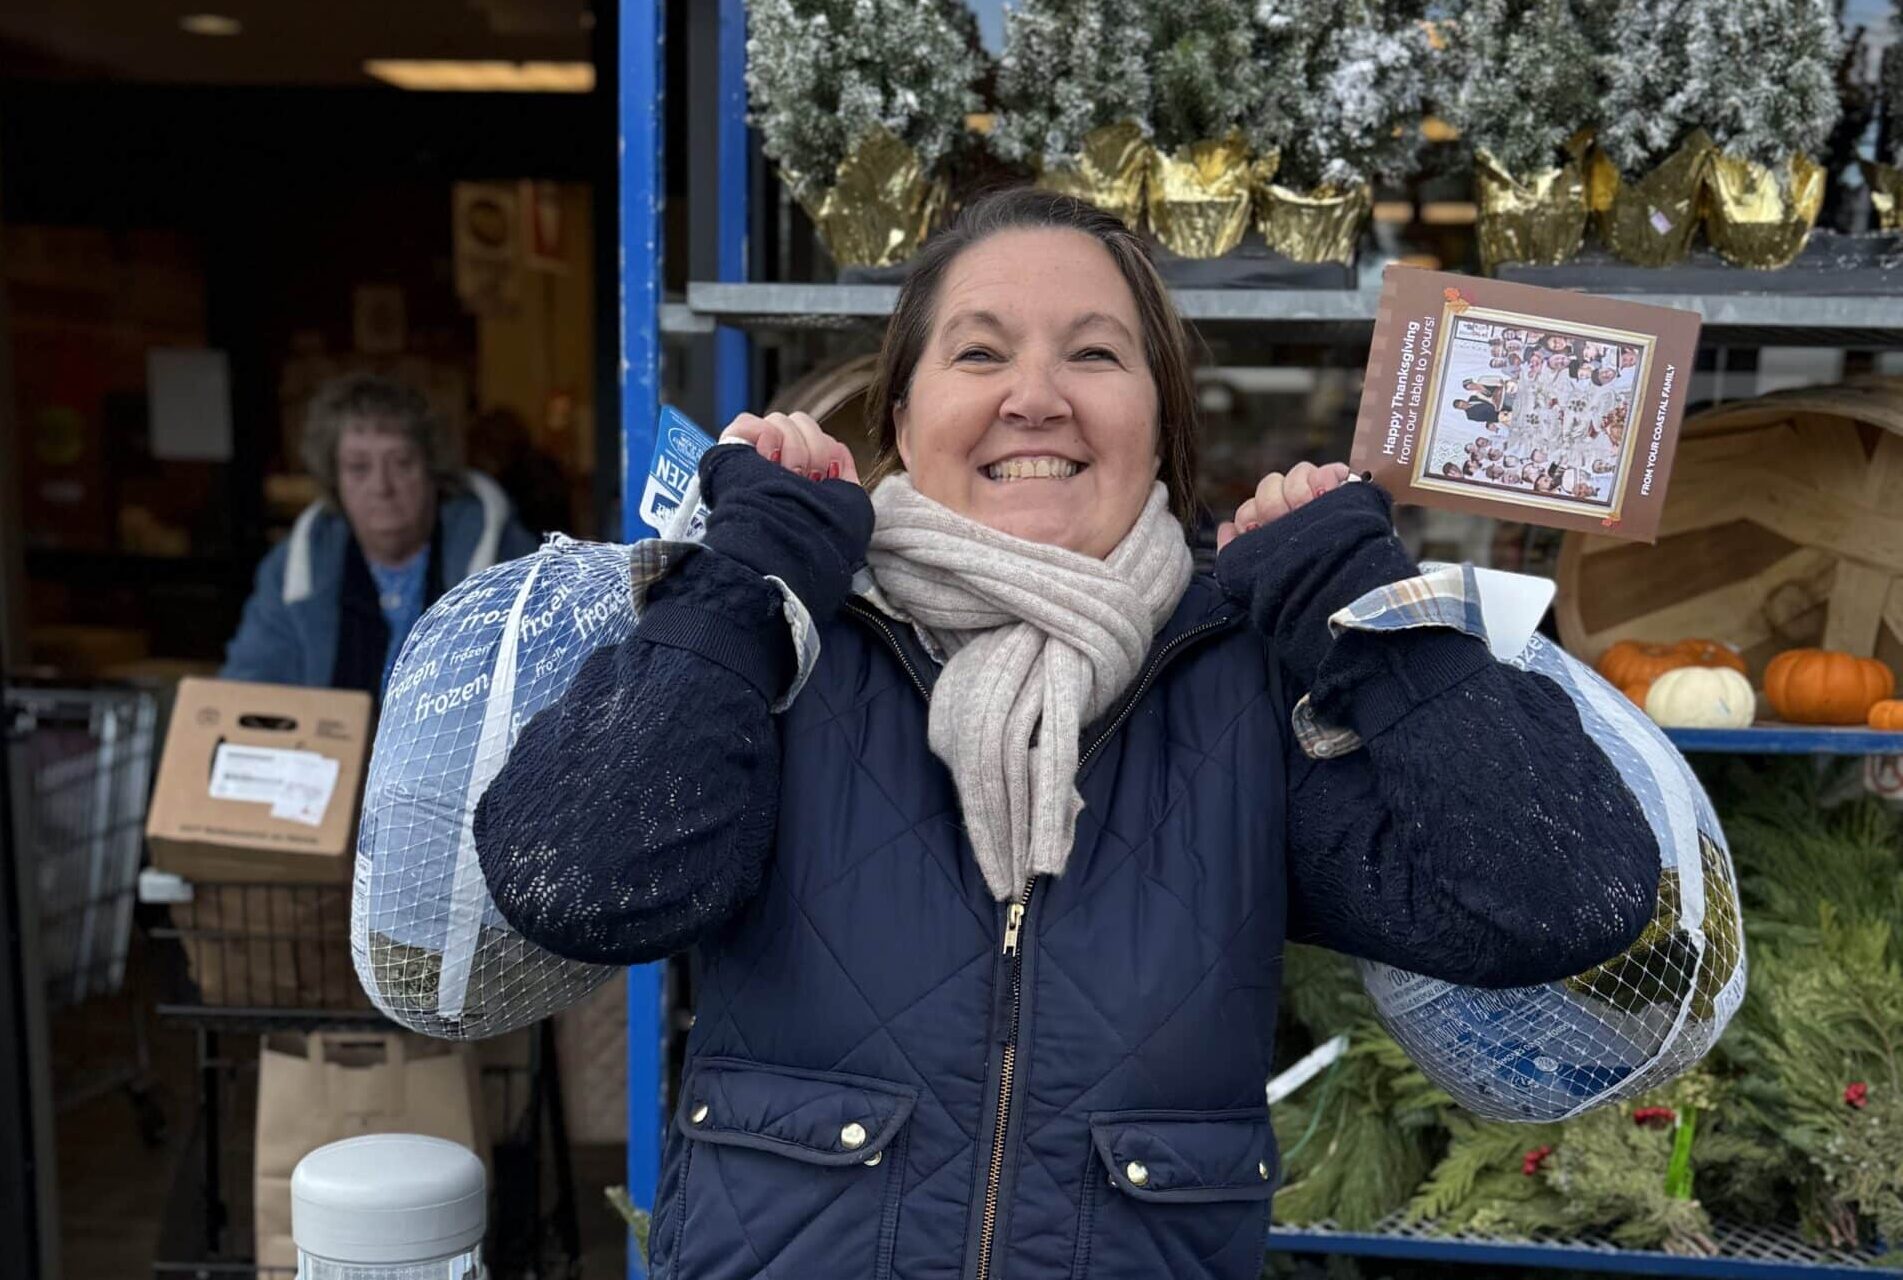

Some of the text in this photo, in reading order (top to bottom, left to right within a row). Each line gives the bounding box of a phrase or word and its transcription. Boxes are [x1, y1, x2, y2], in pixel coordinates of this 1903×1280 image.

[1383, 321, 1420, 455] Happy Thanksgiving
[1397, 316, 1435, 465] from our table to yours!
[1641, 364, 1675, 496] FROM YOUR COASTAL FAMILY
[521, 585, 572, 643] froen
[415, 672, 490, 724] frozen
